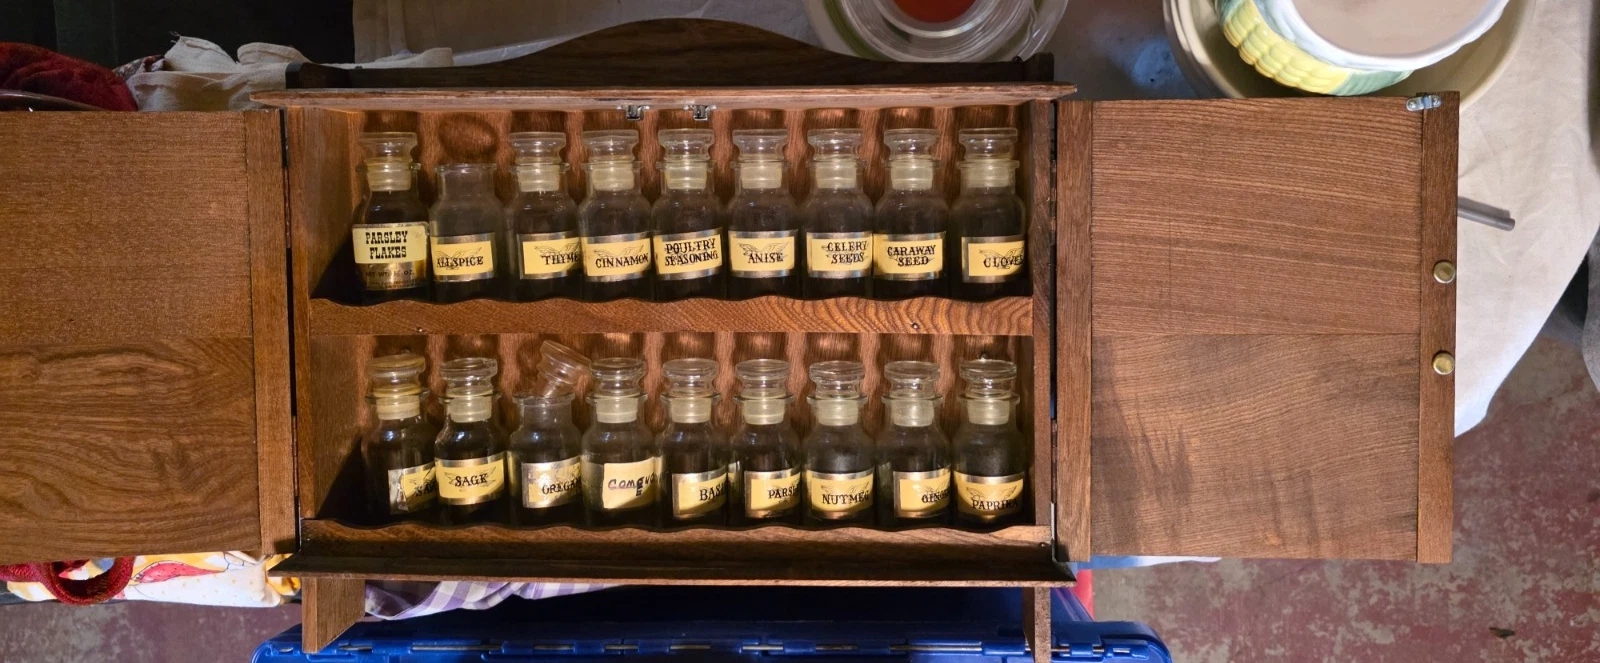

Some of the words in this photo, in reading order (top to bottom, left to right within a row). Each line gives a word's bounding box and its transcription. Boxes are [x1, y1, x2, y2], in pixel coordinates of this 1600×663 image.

[365, 230, 408, 244] PARSLEY
[369, 246, 407, 259] FLAKES
[665, 238, 716, 254] POULTRY
[827, 240, 868, 252] CELERY
[887, 245, 936, 256] CARAWAY
[436, 255, 484, 268] ALLSPICE
[595, 252, 649, 269] CINNAMON
[665, 250, 718, 266] SEASONING
[748, 252, 784, 263] ANISE
[831, 252, 865, 264] SEEDS
[897, 256, 929, 267] SEED
[454, 473, 489, 487] SAGE
[822, 490, 870, 505] NUTMEG
[971, 498, 1018, 511] PAPRIKA
